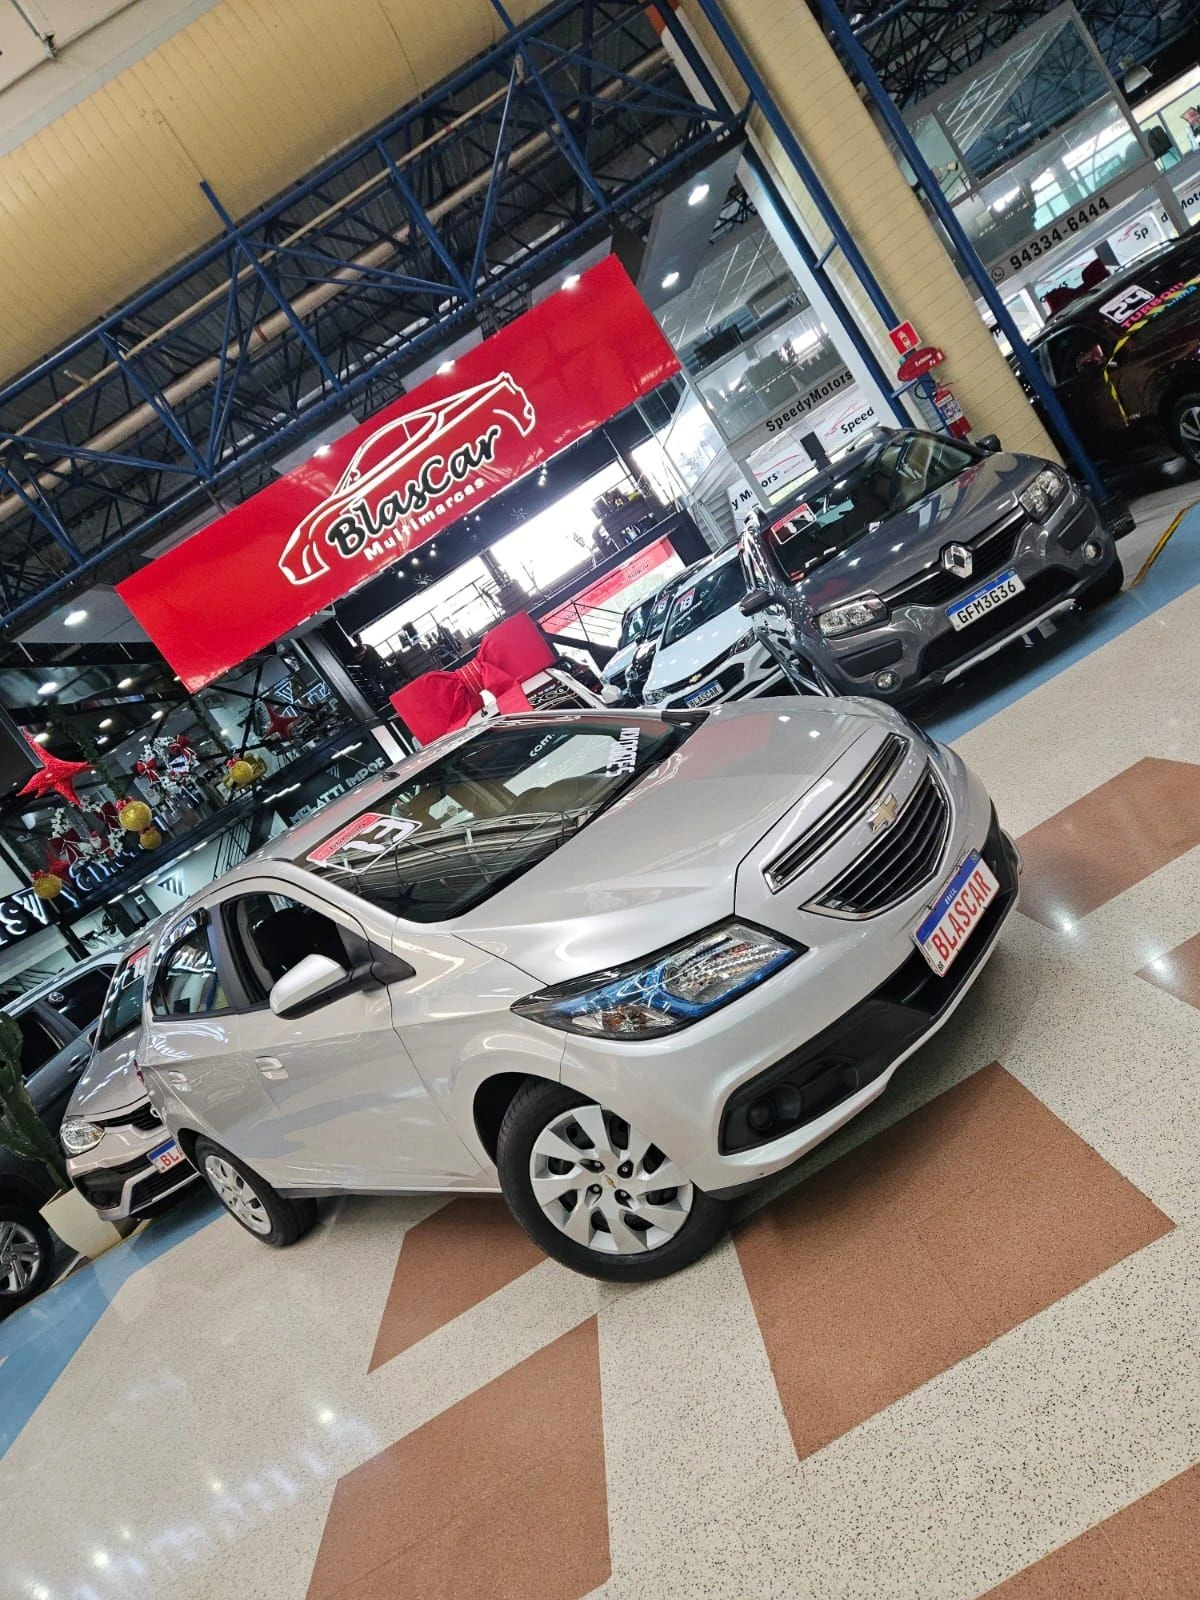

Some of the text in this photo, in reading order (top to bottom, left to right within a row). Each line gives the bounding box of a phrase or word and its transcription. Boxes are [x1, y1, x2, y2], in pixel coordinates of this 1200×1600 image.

[1009, 196, 1111, 270] 94334-6444
[1106, 289, 1152, 320] 24
[765, 370, 853, 433] SpeedyMotors
[326, 425, 501, 558] BlasCar
[363, 477, 486, 561] Multimarcas
[956, 580, 1017, 624] GFM3G36
[689, 686, 720, 708] BLASCAR
[931, 869, 992, 961] BLASCAR
